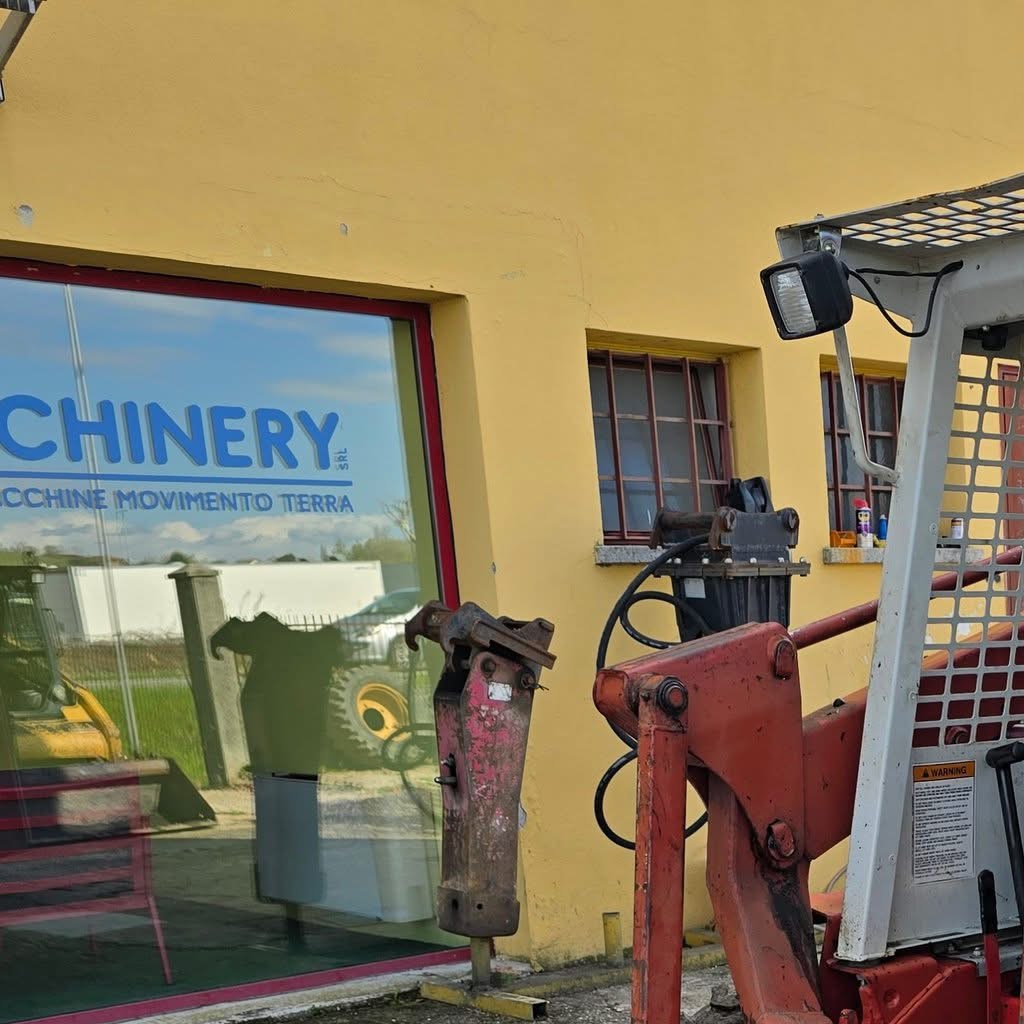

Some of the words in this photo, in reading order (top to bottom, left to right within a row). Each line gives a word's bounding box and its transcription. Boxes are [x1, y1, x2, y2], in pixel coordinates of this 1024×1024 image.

[0, 394, 340, 471] CHINERY
[337, 447, 349, 471] SRL
[0, 486, 108, 510] CCHINE
[115, 489, 273, 512] MOVIMENTO
[282, 493, 354, 514] TERRA
[930, 766, 967, 777] WARNING
